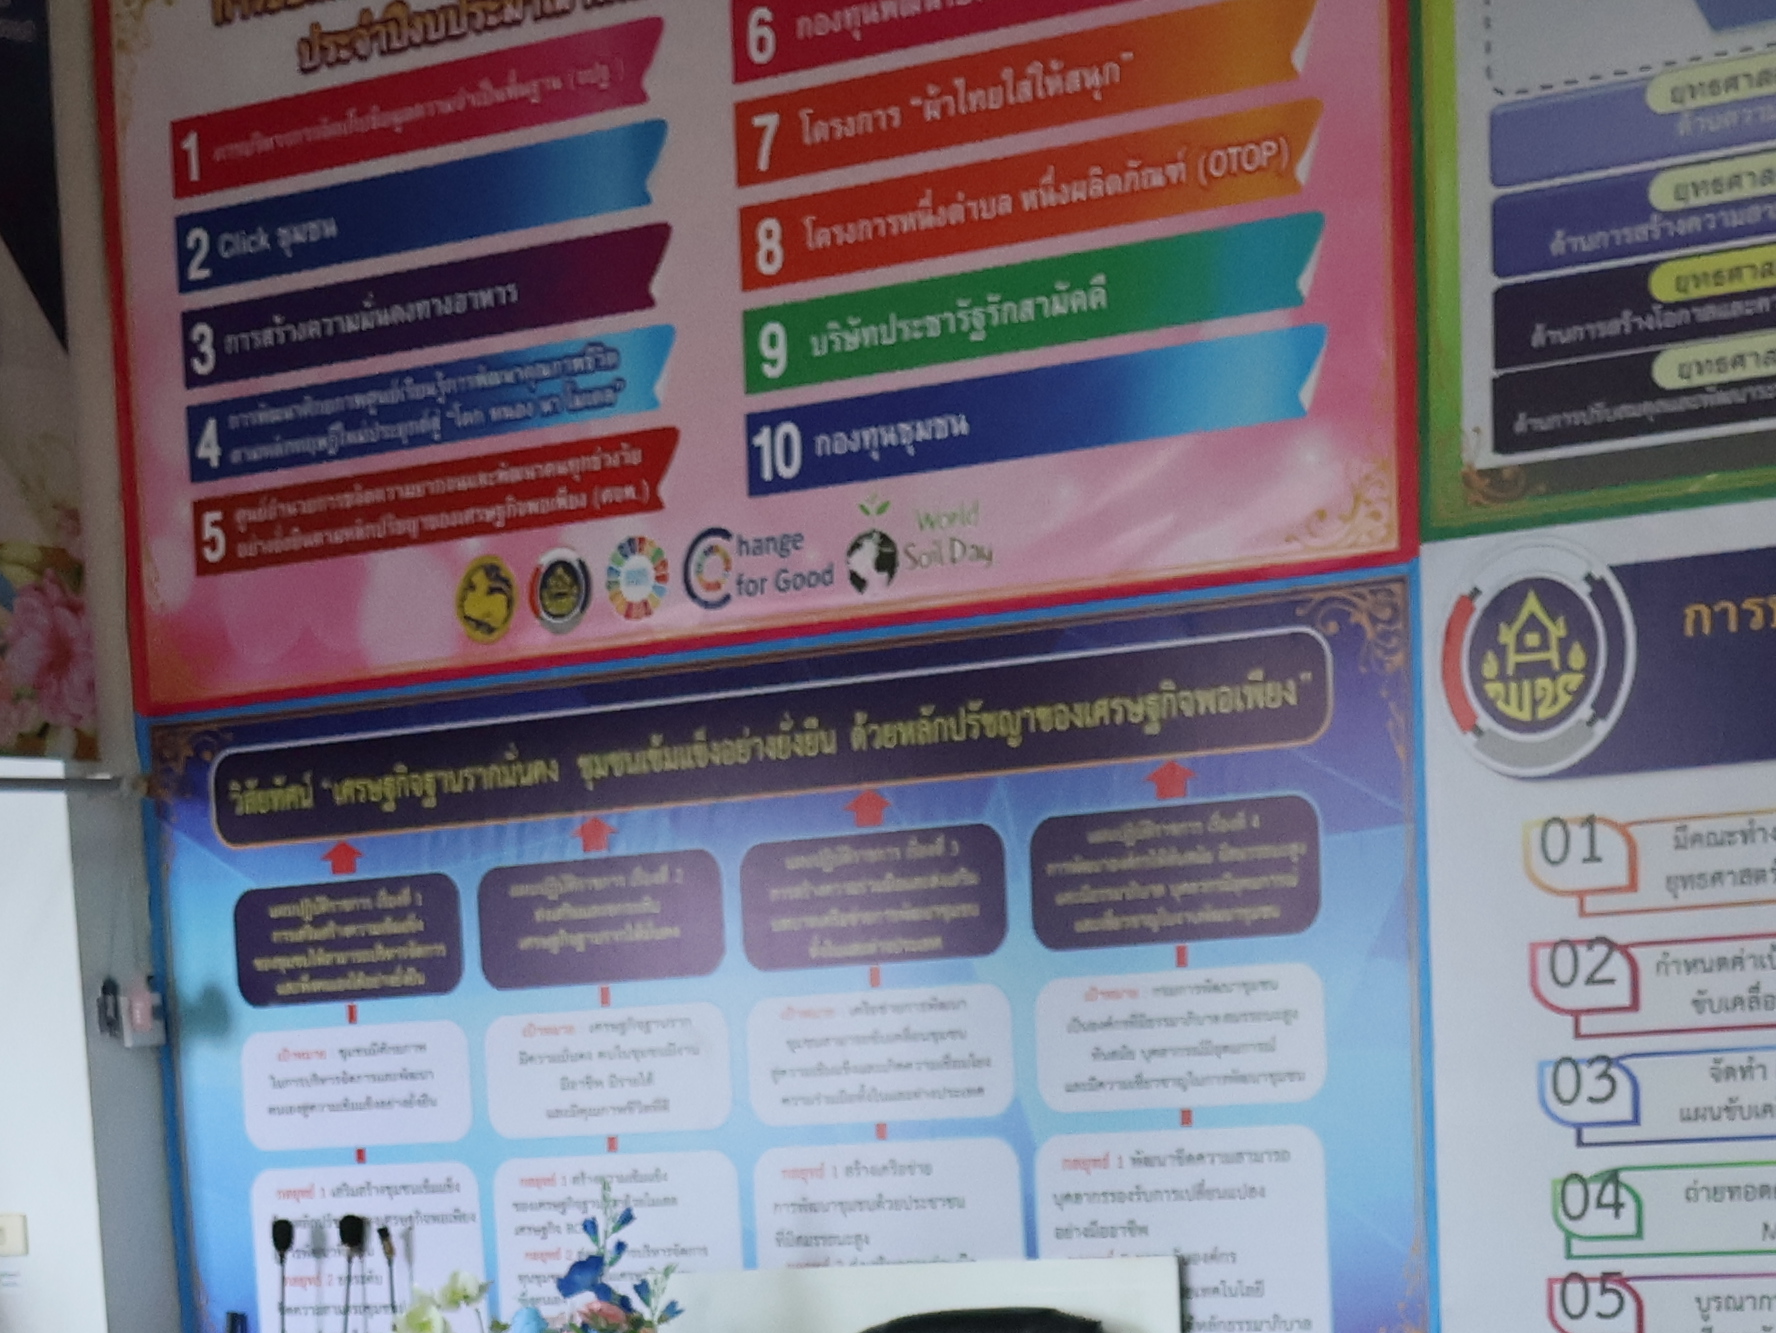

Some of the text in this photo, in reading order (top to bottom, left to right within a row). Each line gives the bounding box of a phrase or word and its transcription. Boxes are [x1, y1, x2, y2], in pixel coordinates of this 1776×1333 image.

[748, 7, 776, 64] 6
[181, 134, 201, 182] 1
[751, 113, 779, 172] 7
[800, 97, 903, 146] โครงการ
[755, 218, 783, 276] 8
[1197, 137, 1291, 187] (OTOP)
[186, 228, 211, 281] 2
[217, 224, 270, 260] Click
[190, 322, 218, 376] 3
[758, 322, 788, 379] 9
[195, 417, 222, 469] 4
[752, 411, 970, 481] 10 กองทุนชุมชน
[200, 510, 225, 562] 5
[735, 564, 835, 599] for Good
[1539, 813, 1605, 868] 01
[1548, 935, 1618, 989] 02
[1550, 1053, 1619, 1109] 03
[1708, 1055, 1768, 1085] จัดทำ
[1558, 1170, 1626, 1223] 04
[1558, 1270, 1626, 1323] 05
